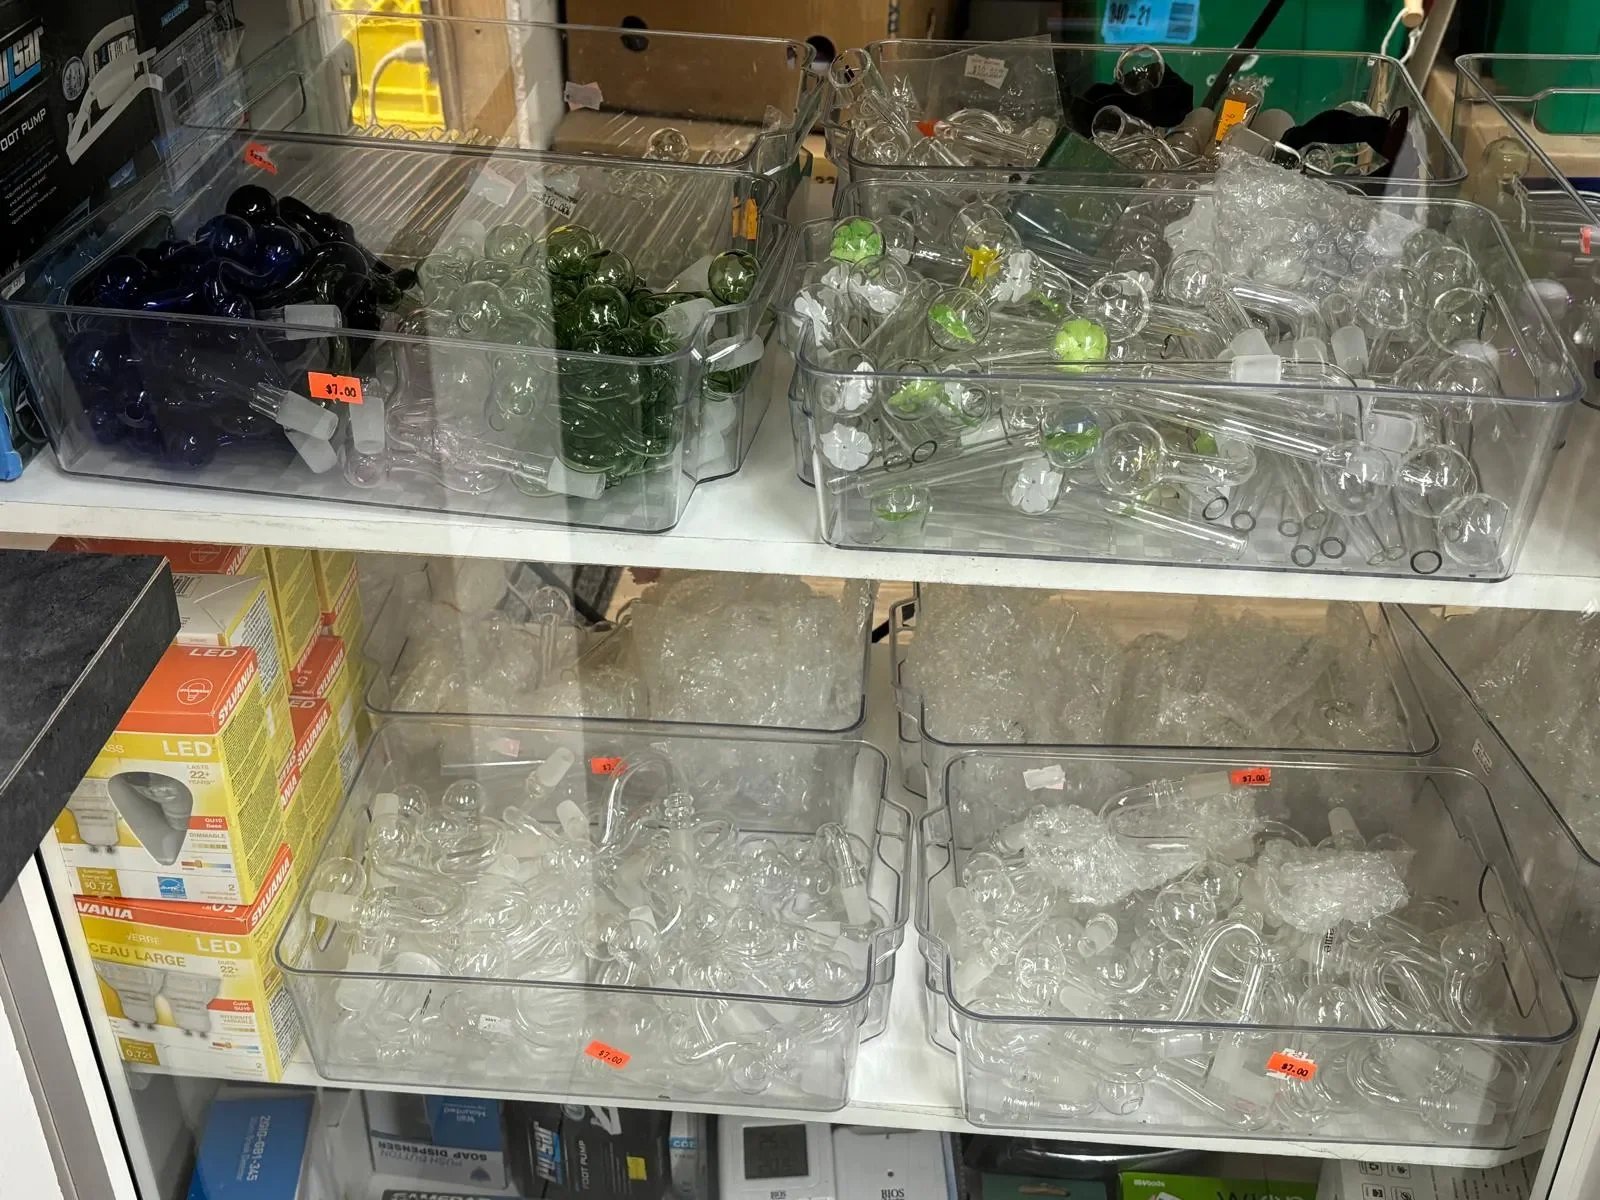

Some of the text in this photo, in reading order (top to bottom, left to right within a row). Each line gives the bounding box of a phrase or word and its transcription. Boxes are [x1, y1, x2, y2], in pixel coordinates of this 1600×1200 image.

[21, 107, 47, 136] PUMP
[325, 384, 357, 397] $7.00
[189, 648, 238, 657] LED
[218, 661, 255, 726] SYLVANIA
[297, 708, 329, 767] SYLVANIA
[162, 739, 213, 757] LED
[251, 857, 291, 927] SYLVANIA
[77, 902, 134, 920] VANIA
[196, 936, 241, 954] LED
[134, 950, 187, 968] LARGE
[599, 1049, 624, 1065] $7.00
[1282, 1062, 1309, 1077] $7.00
[378, 1141, 488, 1161] SOAP DISPENSER
[881, 1188, 904, 1199] BIOS
